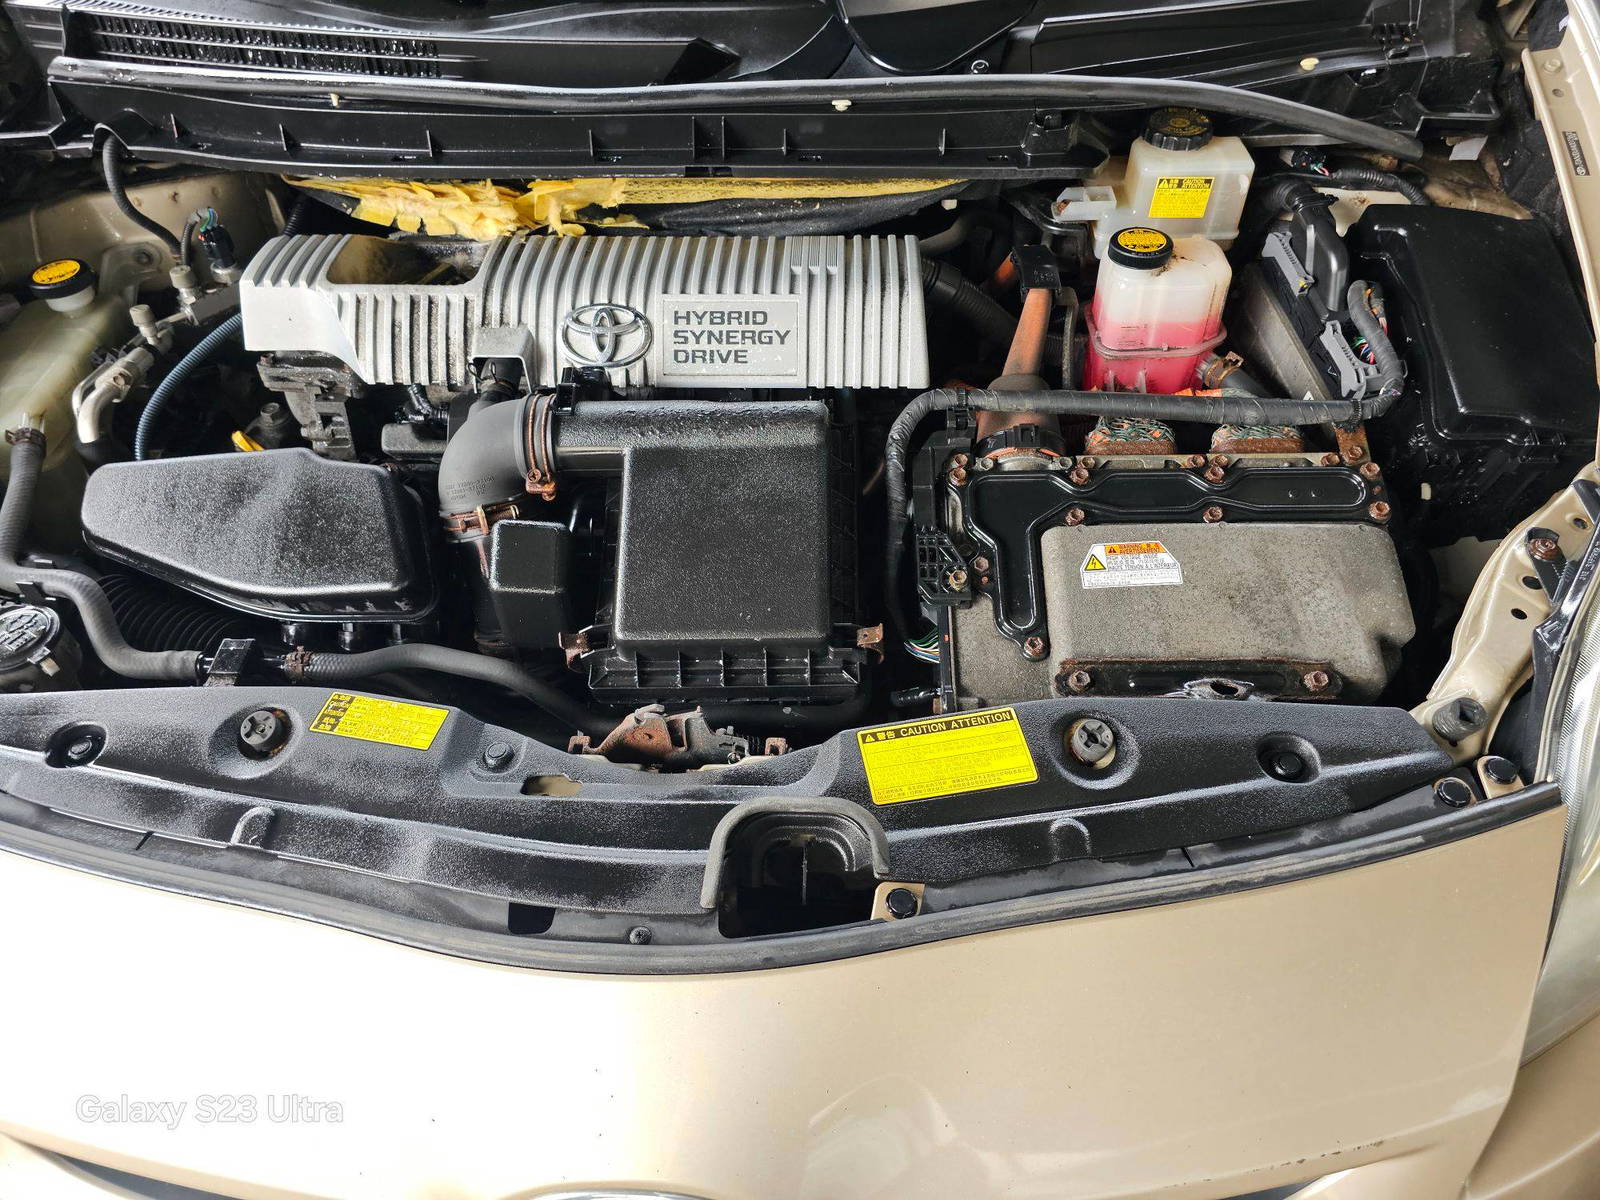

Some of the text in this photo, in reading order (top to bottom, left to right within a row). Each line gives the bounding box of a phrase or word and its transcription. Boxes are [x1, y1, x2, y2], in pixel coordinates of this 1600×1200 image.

[673, 310, 768, 326] HYBRID
[673, 329, 792, 345] SYNERGY
[673, 349, 749, 364] DRIVE
[900, 721, 947, 737] CAUTION
[951, 711, 1012, 730] ATTENTION
